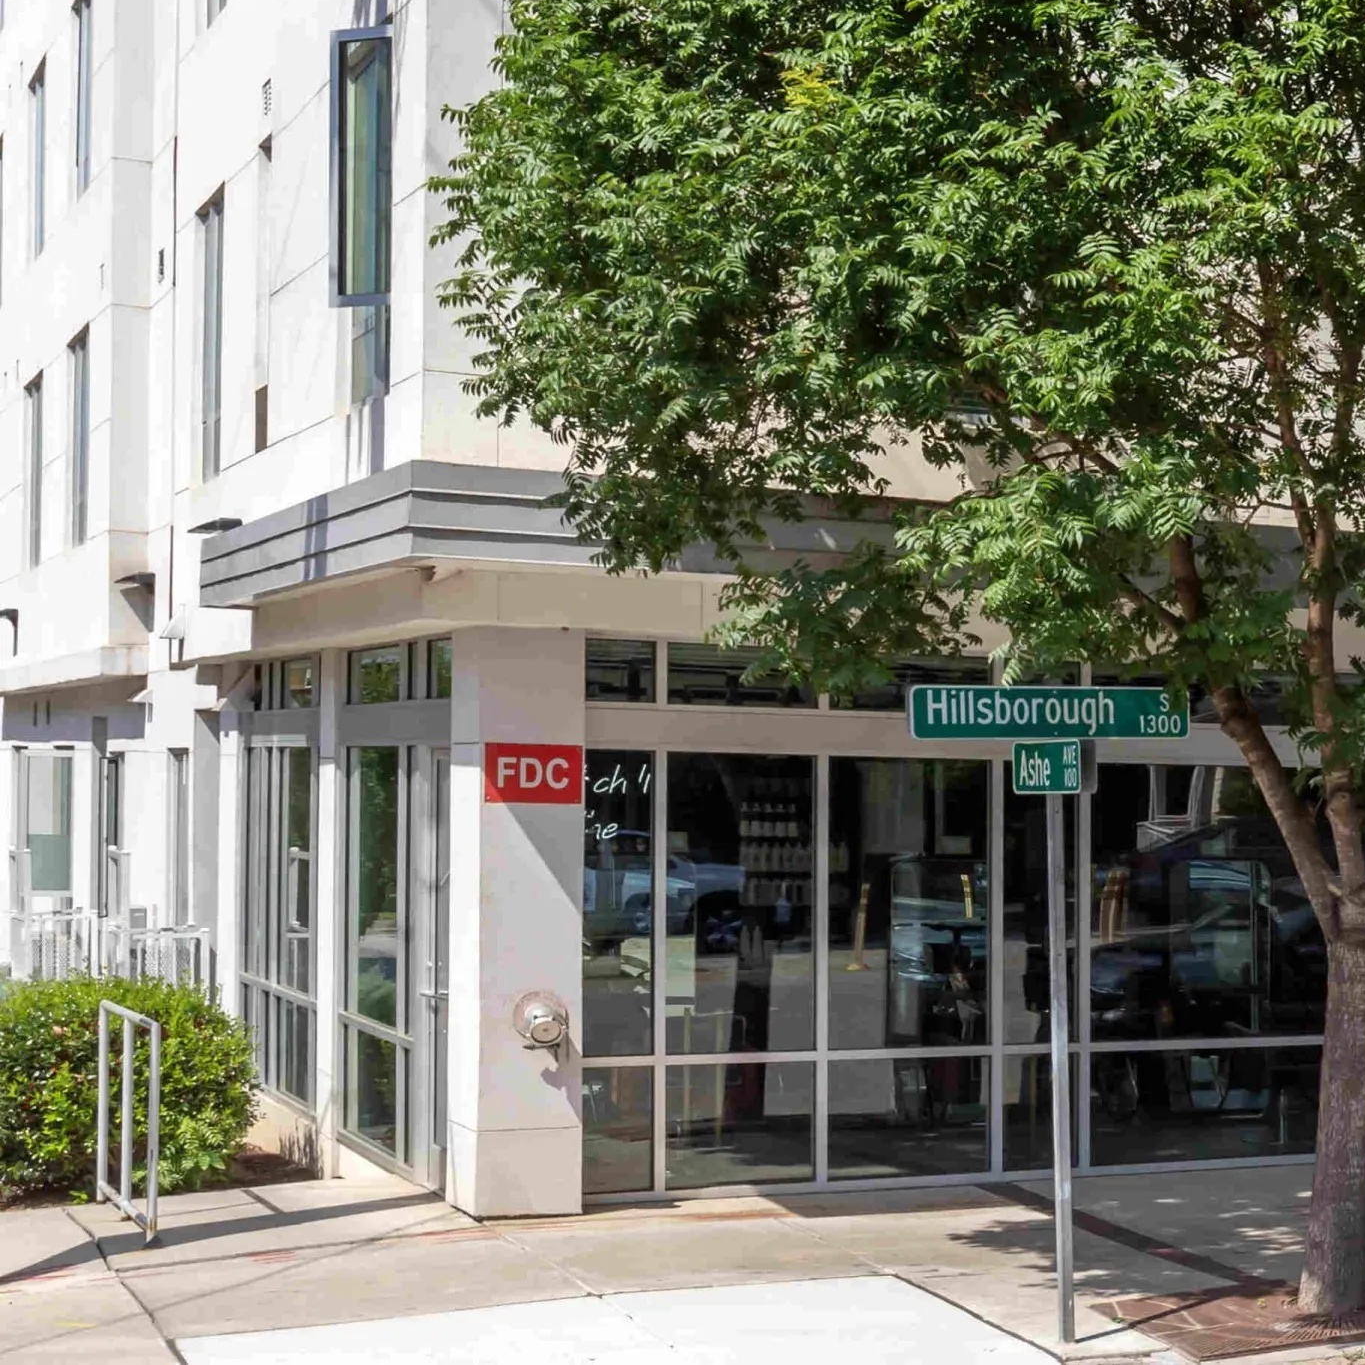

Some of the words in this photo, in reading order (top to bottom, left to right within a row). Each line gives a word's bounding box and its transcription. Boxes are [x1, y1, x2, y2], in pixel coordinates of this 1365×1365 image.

[926, 689, 1115, 736] Hillsborough
[1139, 715, 1181, 734] 1300
[496, 756, 570, 790] FDC
[1020, 750, 1051, 787] Ashe
[1062, 745, 1077, 765] AVE
[1063, 768, 1077, 788] 100
